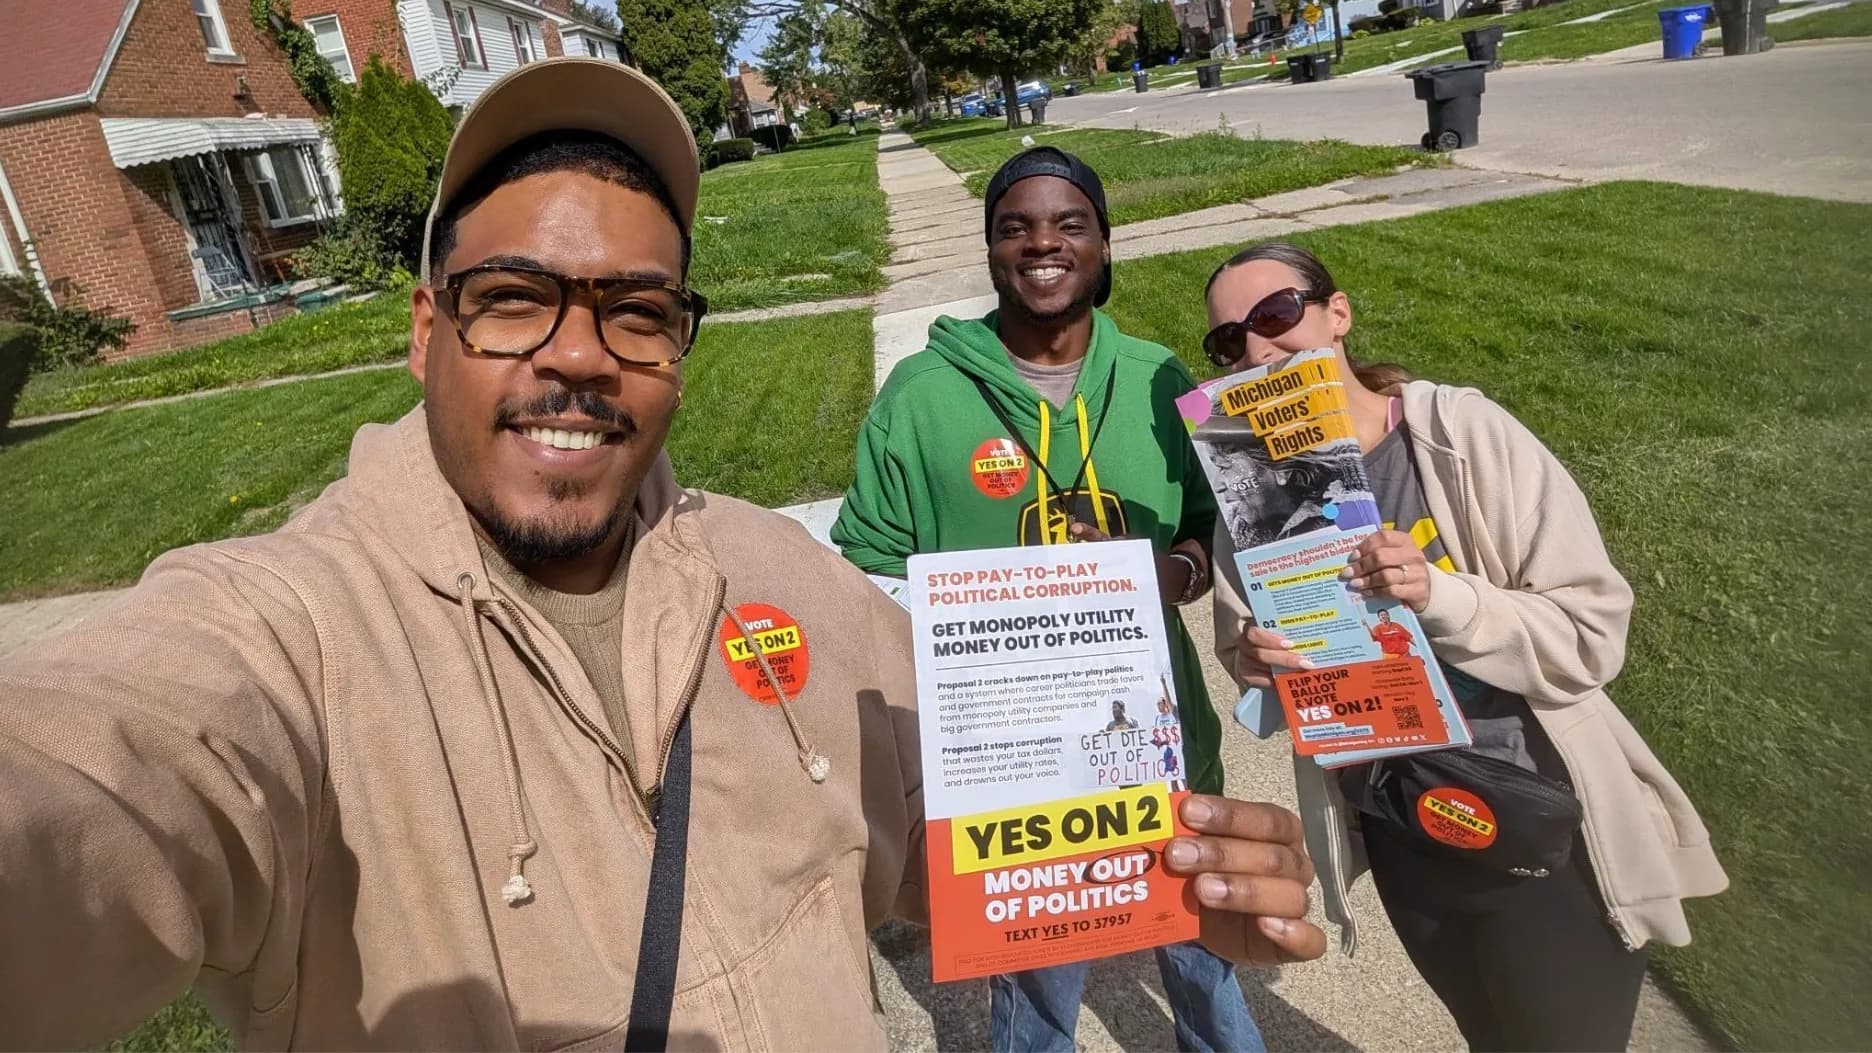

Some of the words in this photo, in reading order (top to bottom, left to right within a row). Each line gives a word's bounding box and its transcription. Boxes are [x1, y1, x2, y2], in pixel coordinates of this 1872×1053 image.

[1226, 371, 1303, 410] Michigan
[1254, 396, 1310, 430] Voters'
[1271, 426, 1325, 455] Rights
[978, 460, 997, 470] YES
[999, 459, 1014, 468] ON
[1231, 477, 1260, 492] VOTE
[1247, 552, 1297, 570] Democracy
[1298, 538, 1341, 555] shouldn't
[1343, 537, 1354, 546] be
[1249, 568, 1268, 578] sale
[1279, 561, 1294, 571] the
[1294, 552, 1329, 568] highest
[927, 571, 974, 588] STOP
[977, 562, 1098, 584] PAY-TO-PLAY
[929, 586, 1021, 606] POLITICAL
[1023, 578, 1137, 599] CORRUPTION.
[1250, 582, 1262, 592] 01
[744, 619, 774, 630] VOTE
[932, 622, 966, 638] GET
[969, 613, 1071, 634] MONOPOLY
[1074, 608, 1135, 626] UTILITY
[1263, 620, 1277, 629] 02
[764, 633, 786, 648] ON
[786, 631, 796, 644] 2
[933, 637, 1000, 658] MONEY
[1004, 634, 1040, 651] OUT
[1044, 632, 1066, 648] OF
[1069, 626, 1148, 646] POLITICS.
[757, 674, 796, 689] POTICS
[758, 666, 777, 678] OT
[778, 665, 789, 674] OF
[937, 680, 976, 691] Proposal
[984, 676, 1014, 686] cracks
[1014, 674, 1039, 682] down
[1040, 673, 1051, 681] on
[1052, 668, 1104, 682] pay-to-play
[1104, 664, 1134, 677] politics
[1288, 676, 1312, 688] FLIP
[1314, 669, 1349, 683] YOUR
[938, 692, 956, 700] and
[965, 689, 996, 700] system
[998, 686, 1024, 695] where
[1025, 682, 1052, 693] career
[1054, 680, 1096, 692] politicians
[1097, 676, 1118, 685] trade
[1120, 674, 1144, 683] favors
[1290, 682, 1336, 698] BALLOT
[939, 702, 956, 712] and
[958, 698, 1012, 712] government
[1012, 694, 1054, 705] contracts
[1054, 692, 1066, 701] for
[1068, 688, 1110, 699] campaign
[1111, 686, 1130, 694] cash
[940, 714, 961, 722] from
[962, 709, 1006, 720] monopoly
[1008, 706, 1032, 716] utility
[1032, 702, 1080, 713] companies
[1080, 699, 1097, 708] and
[1295, 700, 1304, 708] &
[1304, 693, 1338, 706] VOTE
[1296, 705, 1332, 722] YES
[1334, 700, 1362, 716] ON
[1364, 696, 1382, 712] 2!
[940, 724, 955, 734] big
[956, 720, 1010, 734] government
[1012, 715, 1064, 727] contractors.
[942, 744, 982, 756] Proposal
[990, 740, 1014, 750] stops
[1016, 736, 1063, 748] corruption
[1081, 732, 1112, 750] GET
[1120, 729, 1148, 748] DTE
[1152, 726, 1180, 750] $$$
[942, 757, 961, 766] that
[962, 754, 994, 764] wastes
[996, 752, 1015, 763] your
[1017, 749, 1032, 758] tax
[1032, 746, 1064, 757] dollars,
[1090, 751, 1118, 767] OUT
[1126, 748, 1144, 762] OF
[944, 766, 986, 776] increases
[988, 764, 1008, 774] your
[1010, 760, 1034, 772] utility
[944, 778, 962, 788] and
[964, 776, 996, 786] drowns
[998, 773, 1013, 782] out
[1014, 772, 1034, 782] your
[1036, 768, 1060, 778] voice.
[1430, 800, 1454, 816] YES
[1456, 813, 1478, 828] ON
[1479, 824, 1489, 832] 2
[1450, 798, 1476, 816] VOTE
[966, 814, 1052, 860] YES
[1061, 800, 1129, 844] ON
[1136, 795, 1161, 832] 2
[984, 861, 1088, 895] MONEY
[1092, 853, 1148, 881] OUT
[985, 898, 1023, 922] OF
[1028, 880, 1148, 918] POLITICS
[1004, 927, 1038, 942] TEXT
[1042, 923, 1069, 938] YES
[1072, 920, 1090, 933] TO
[1094, 913, 1132, 930] 37957
